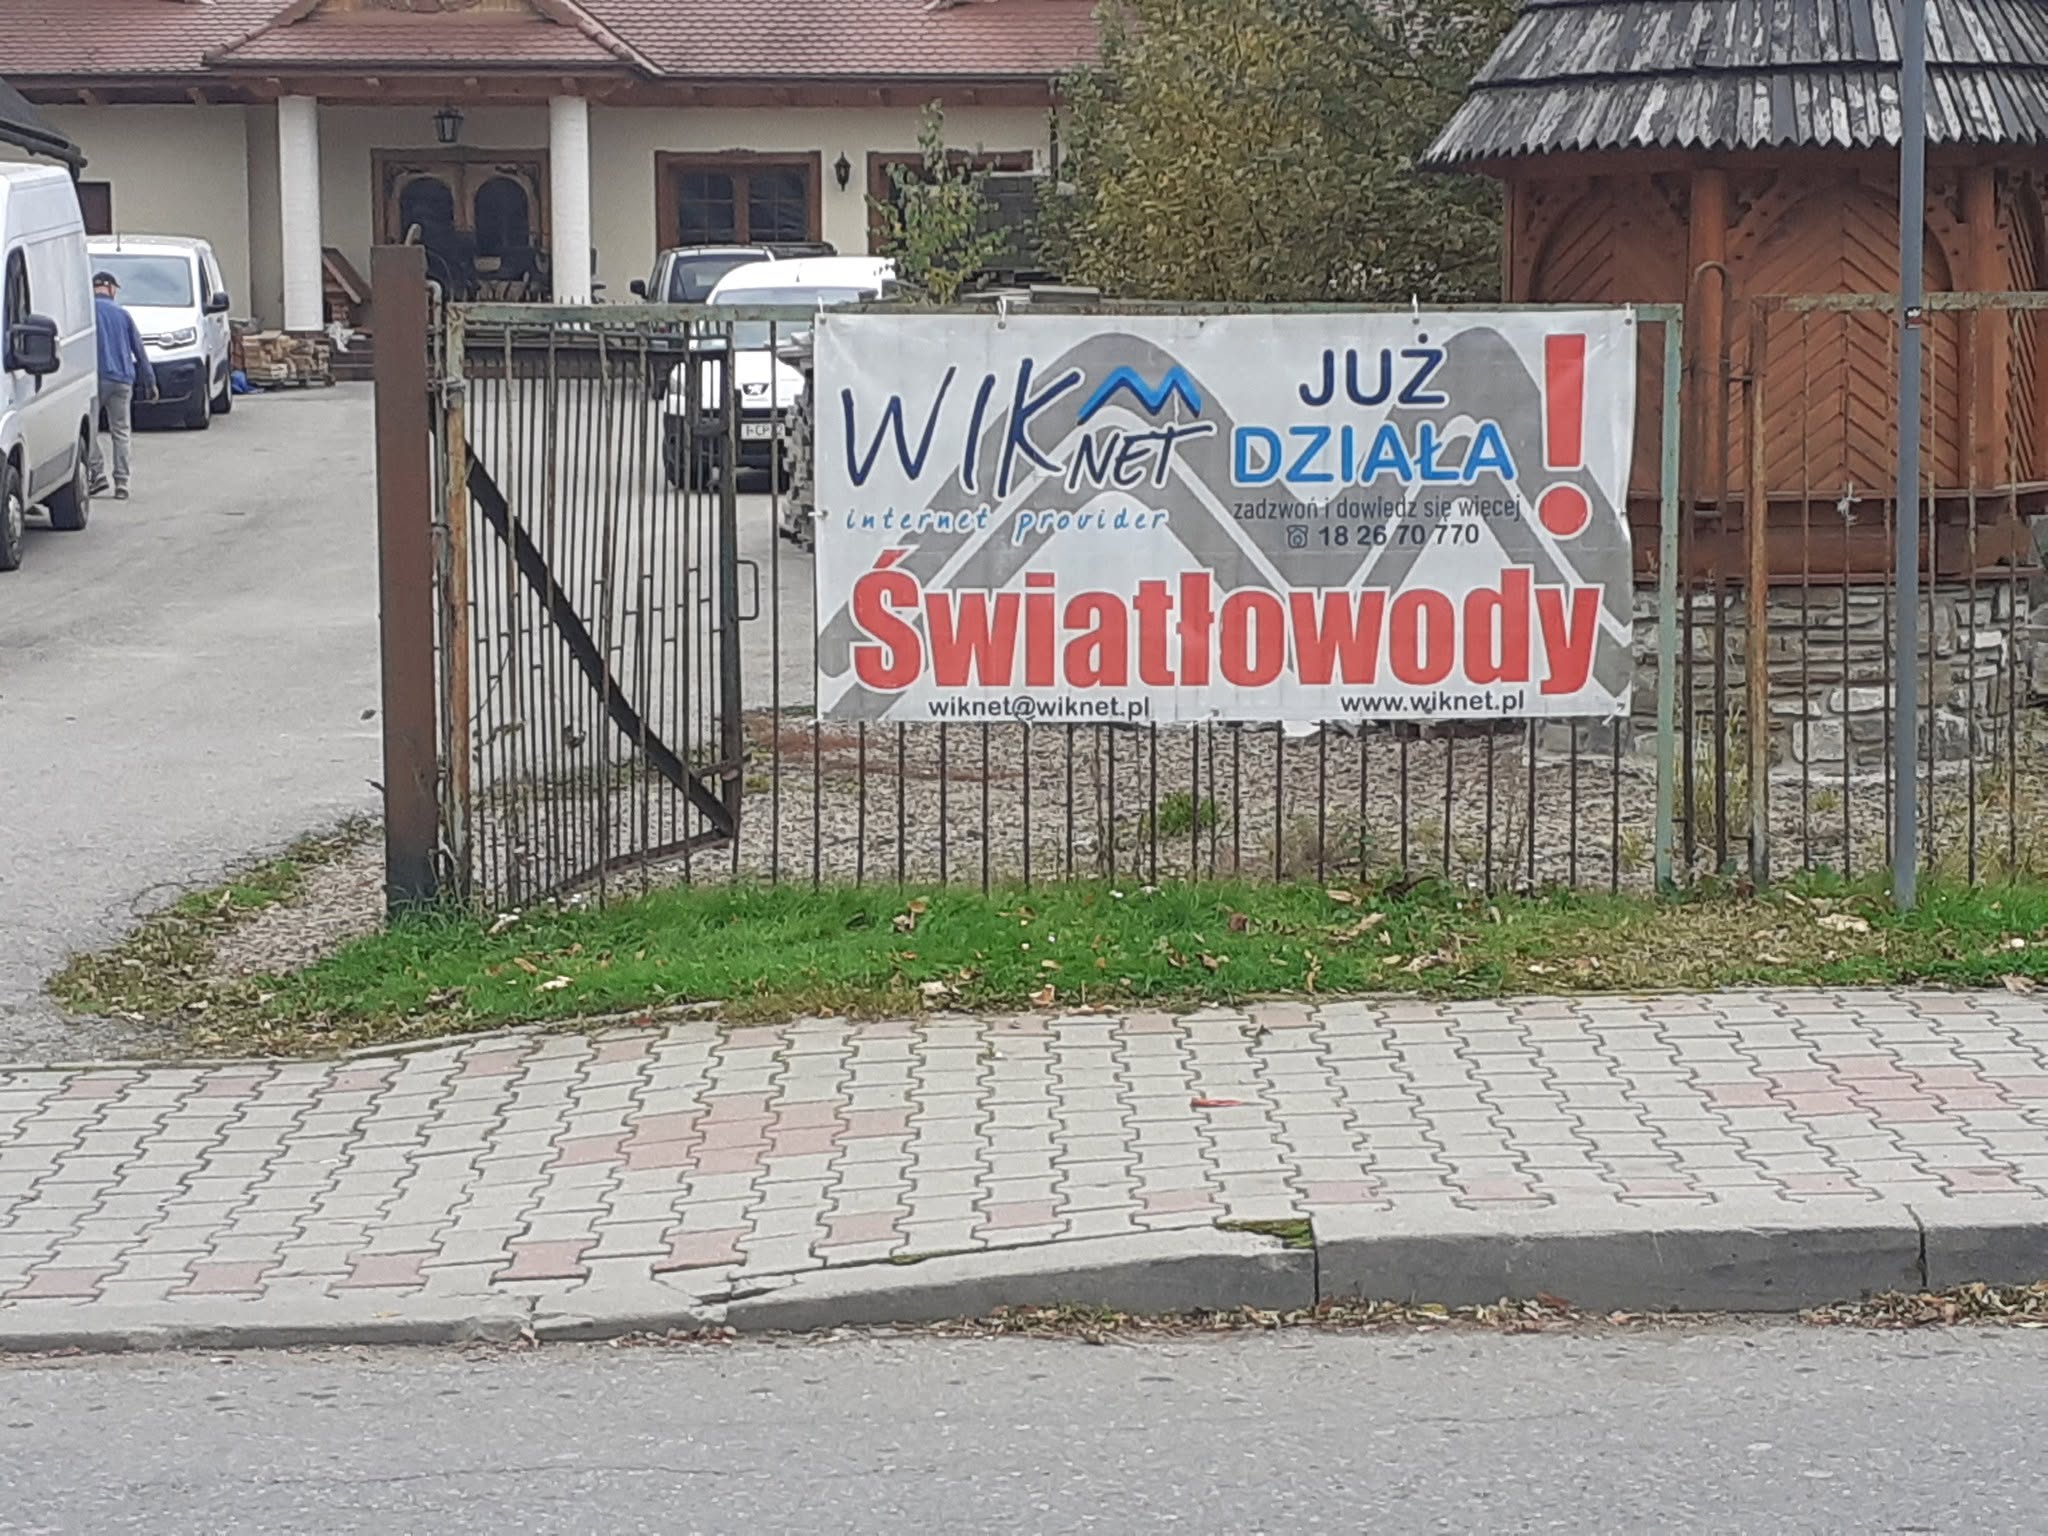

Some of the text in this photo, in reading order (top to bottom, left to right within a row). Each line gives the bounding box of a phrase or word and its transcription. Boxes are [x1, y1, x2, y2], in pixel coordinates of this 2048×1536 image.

[1299, 333, 1445, 406] JUŻ
[1233, 422, 1515, 484] DZIAŁA
[1233, 494, 1522, 523] zadzwoń i dowiedz się więcej
[846, 508, 1169, 545] internet provider
[1319, 524, 1480, 546] 18 26 70 770
[852, 548, 1601, 696] Światłowody
[928, 695, 1151, 721] wiknet@wiknet.pl
[1340, 690, 1524, 713] www.wiknet.pl
